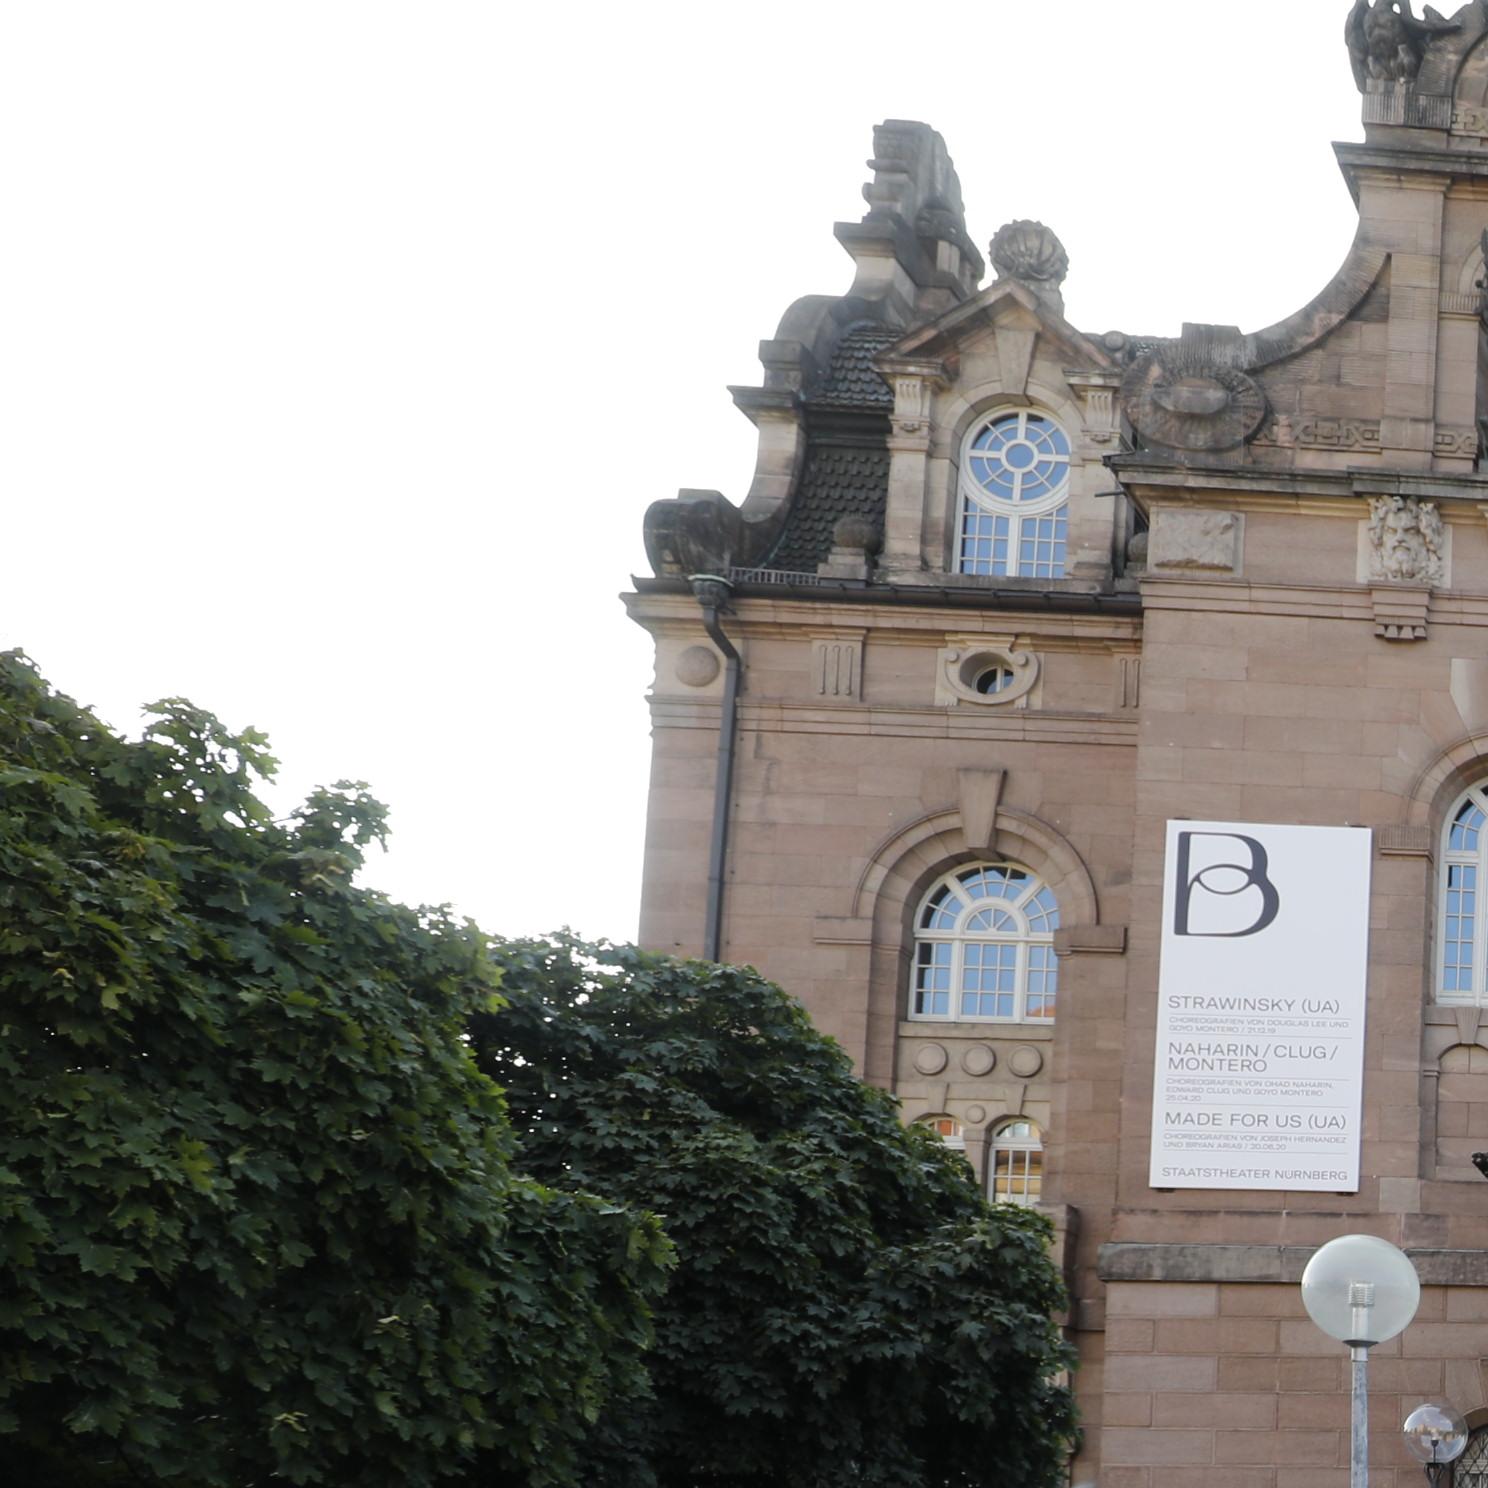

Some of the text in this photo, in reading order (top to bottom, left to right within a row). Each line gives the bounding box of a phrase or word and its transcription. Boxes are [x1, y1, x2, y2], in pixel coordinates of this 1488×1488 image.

[1173, 830, 1280, 937] B
[1168, 995, 1340, 1015] STRAWINSKY (UA)
[1246, 1018, 1265, 1026] VON
[1267, 1018, 1309, 1028] DOUGLAS
[1311, 1020, 1327, 1028] LEE
[1328, 1020, 1349, 1028] UND
[1195, 1025, 1240, 1034] MONTERO
[1168, 1042, 1259, 1057] NAHARIN
[1273, 1044, 1327, 1059] CLUG
[1168, 1057, 1268, 1073] MONTERO
[1244, 1079, 1262, 1088] VON
[1232, 1088, 1252, 1096] UND
[1280, 1089, 1324, 1097] MONTERO
[1164, 1112, 1346, 1130] MADE FOR US (UA)
[1239, 1134, 1258, 1142] VON
[1260, 1135, 1292, 1143] JOSEPH
[1293, 1135, 1347, 1144] HERNANDEZ
[1163, 1141, 1184, 1149] UND
[1161, 1167, 1270, 1179] STAATSTHEATER
